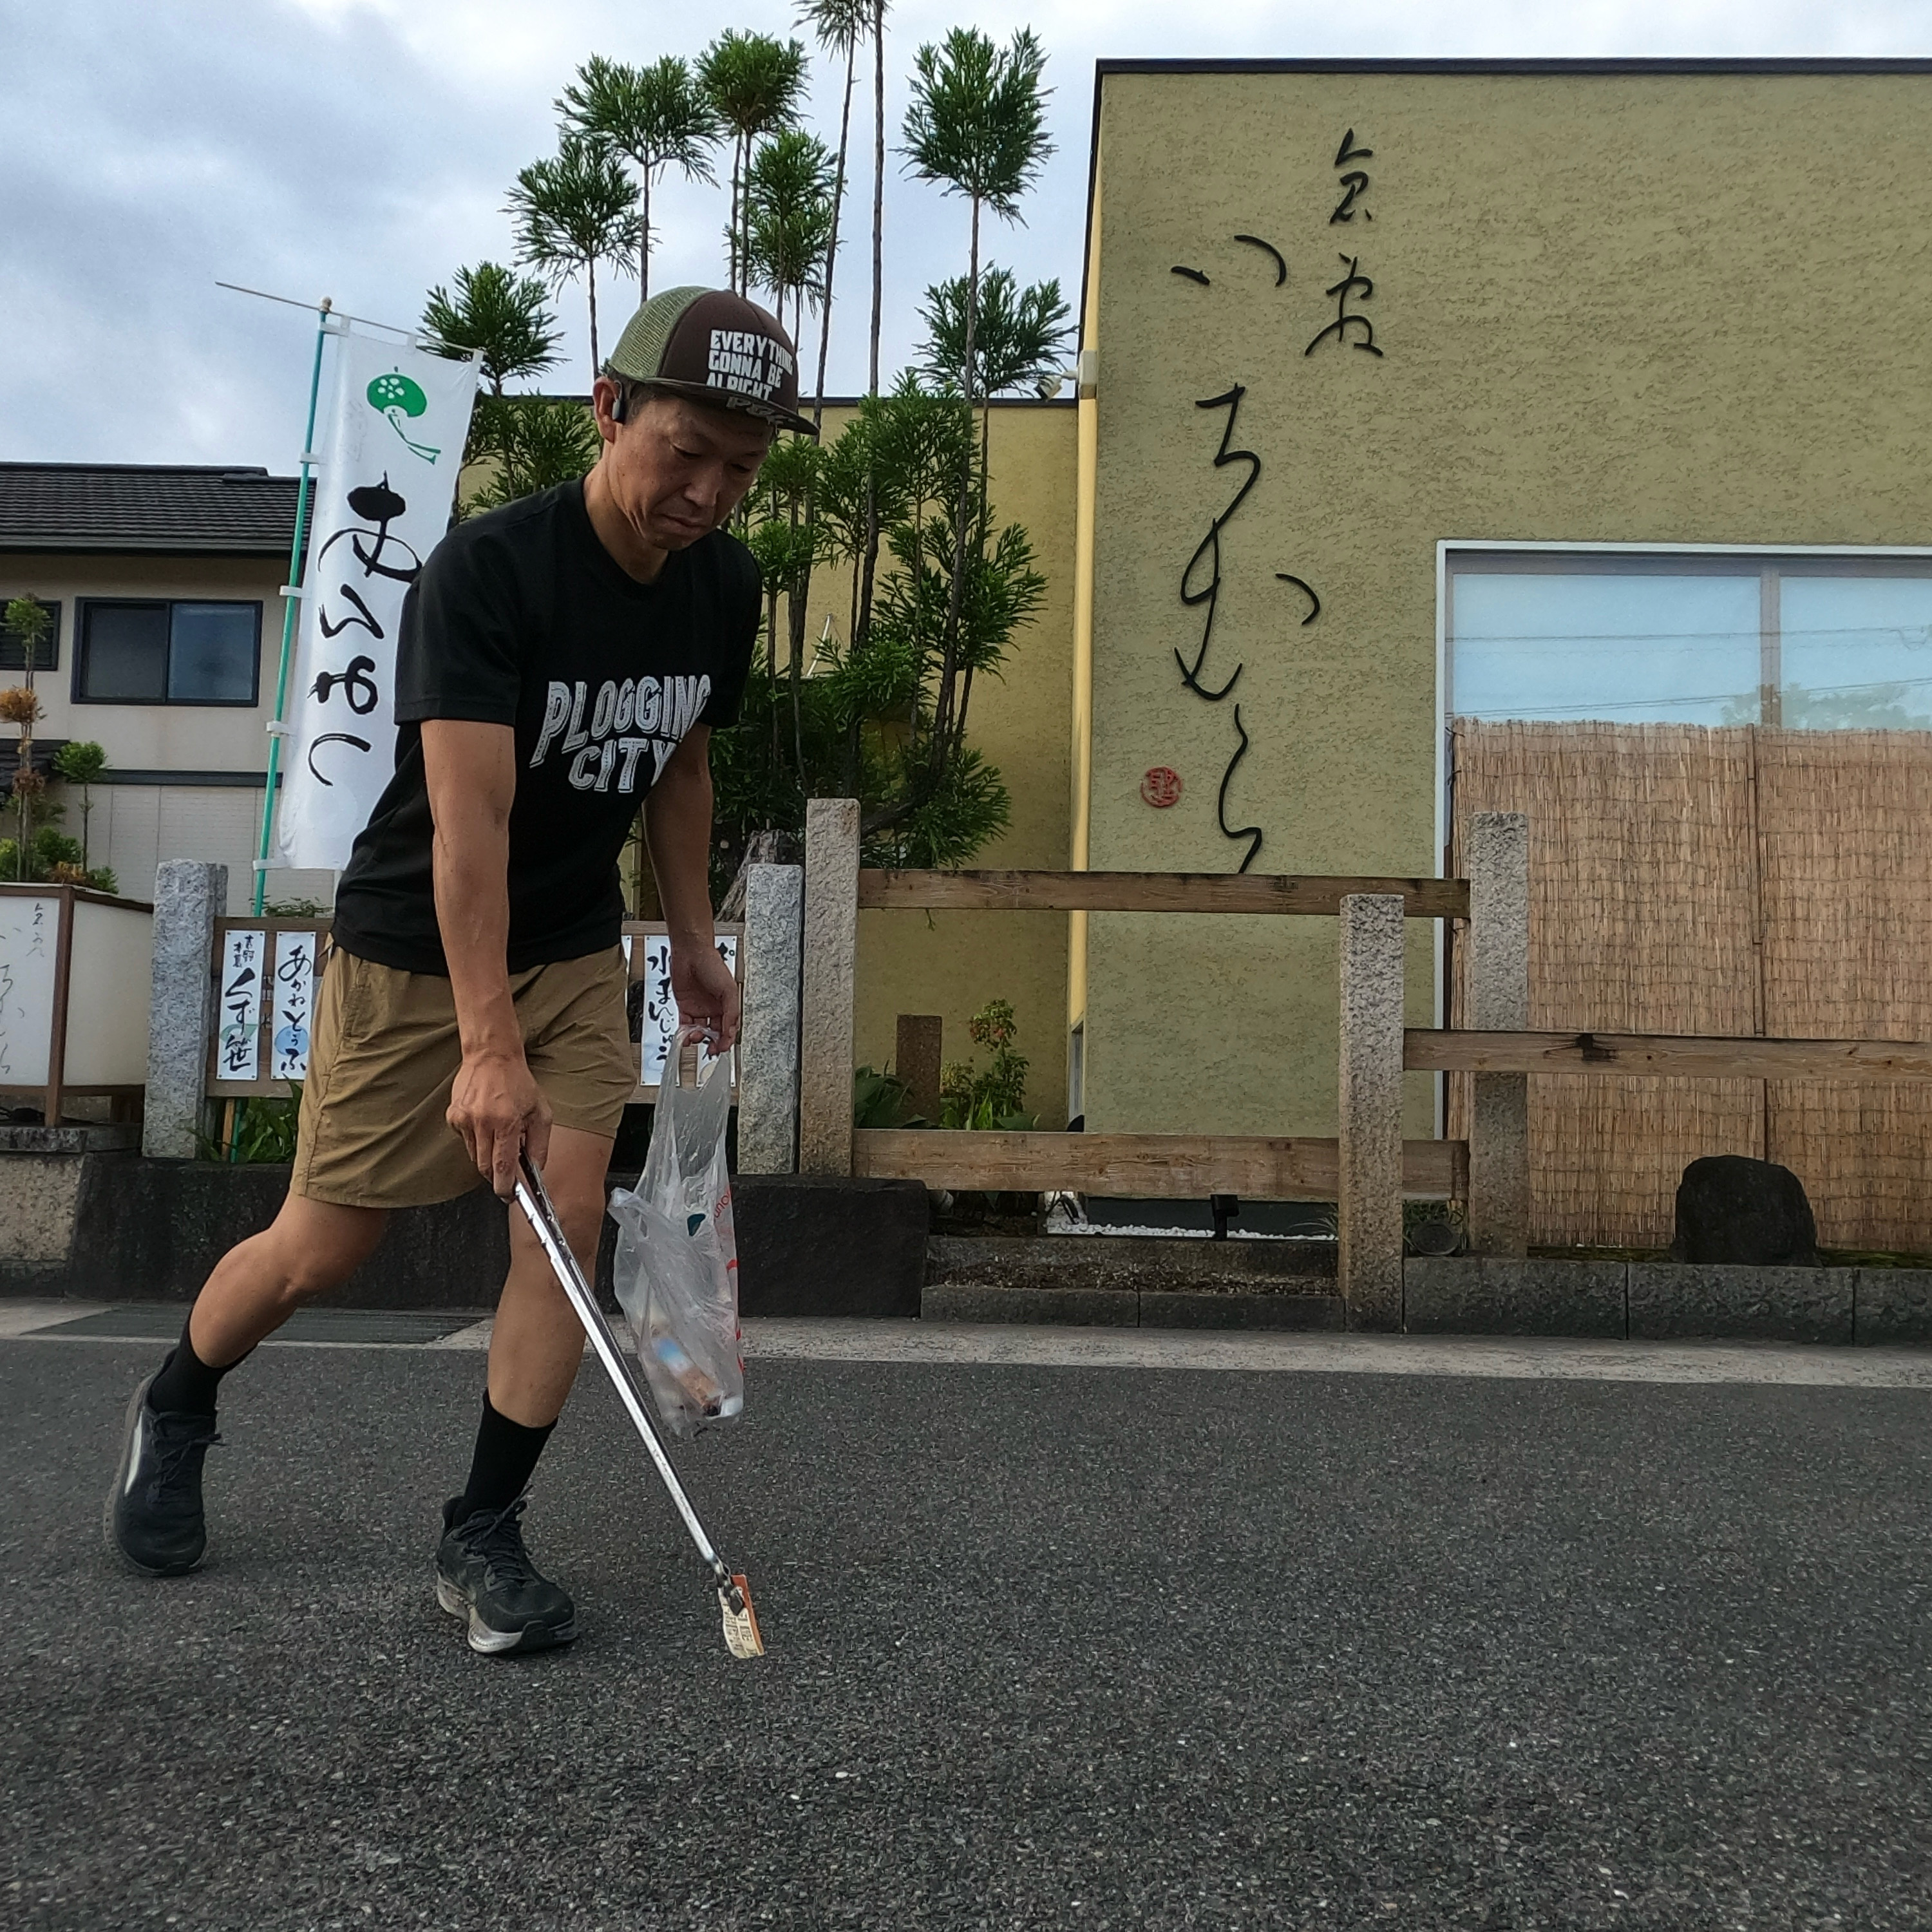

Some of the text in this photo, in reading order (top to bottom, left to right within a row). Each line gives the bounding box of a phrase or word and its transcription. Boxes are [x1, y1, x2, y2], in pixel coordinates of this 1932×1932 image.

[708, 350, 784, 388] GONNA BE
[710, 329, 793, 376] EVERYTHING
[567, 737, 678, 794] CITY
